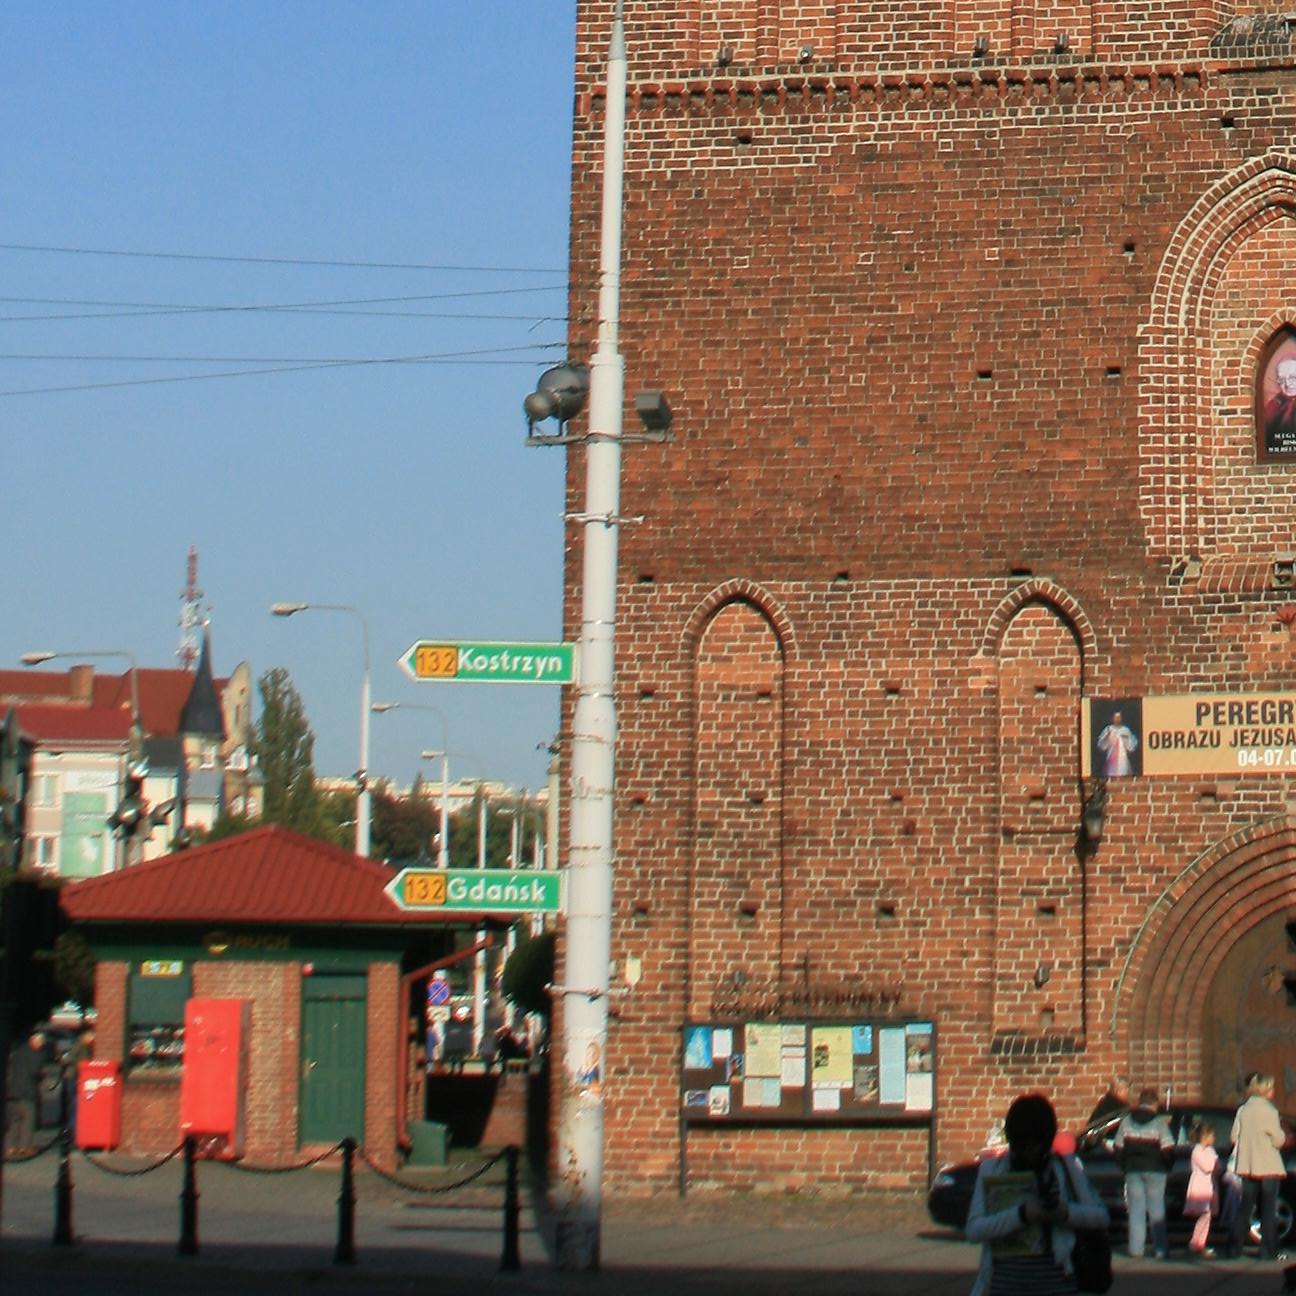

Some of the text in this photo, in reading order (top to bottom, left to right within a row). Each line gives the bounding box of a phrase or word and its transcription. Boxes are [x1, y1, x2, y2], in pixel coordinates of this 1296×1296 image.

[417, 648, 563, 679] 132 Kostrzyn
[1149, 730, 1221, 750] OBRAZU
[1229, 727, 1296, 748] JEZUSA
[406, 874, 546, 901] 132 Gdańsk
